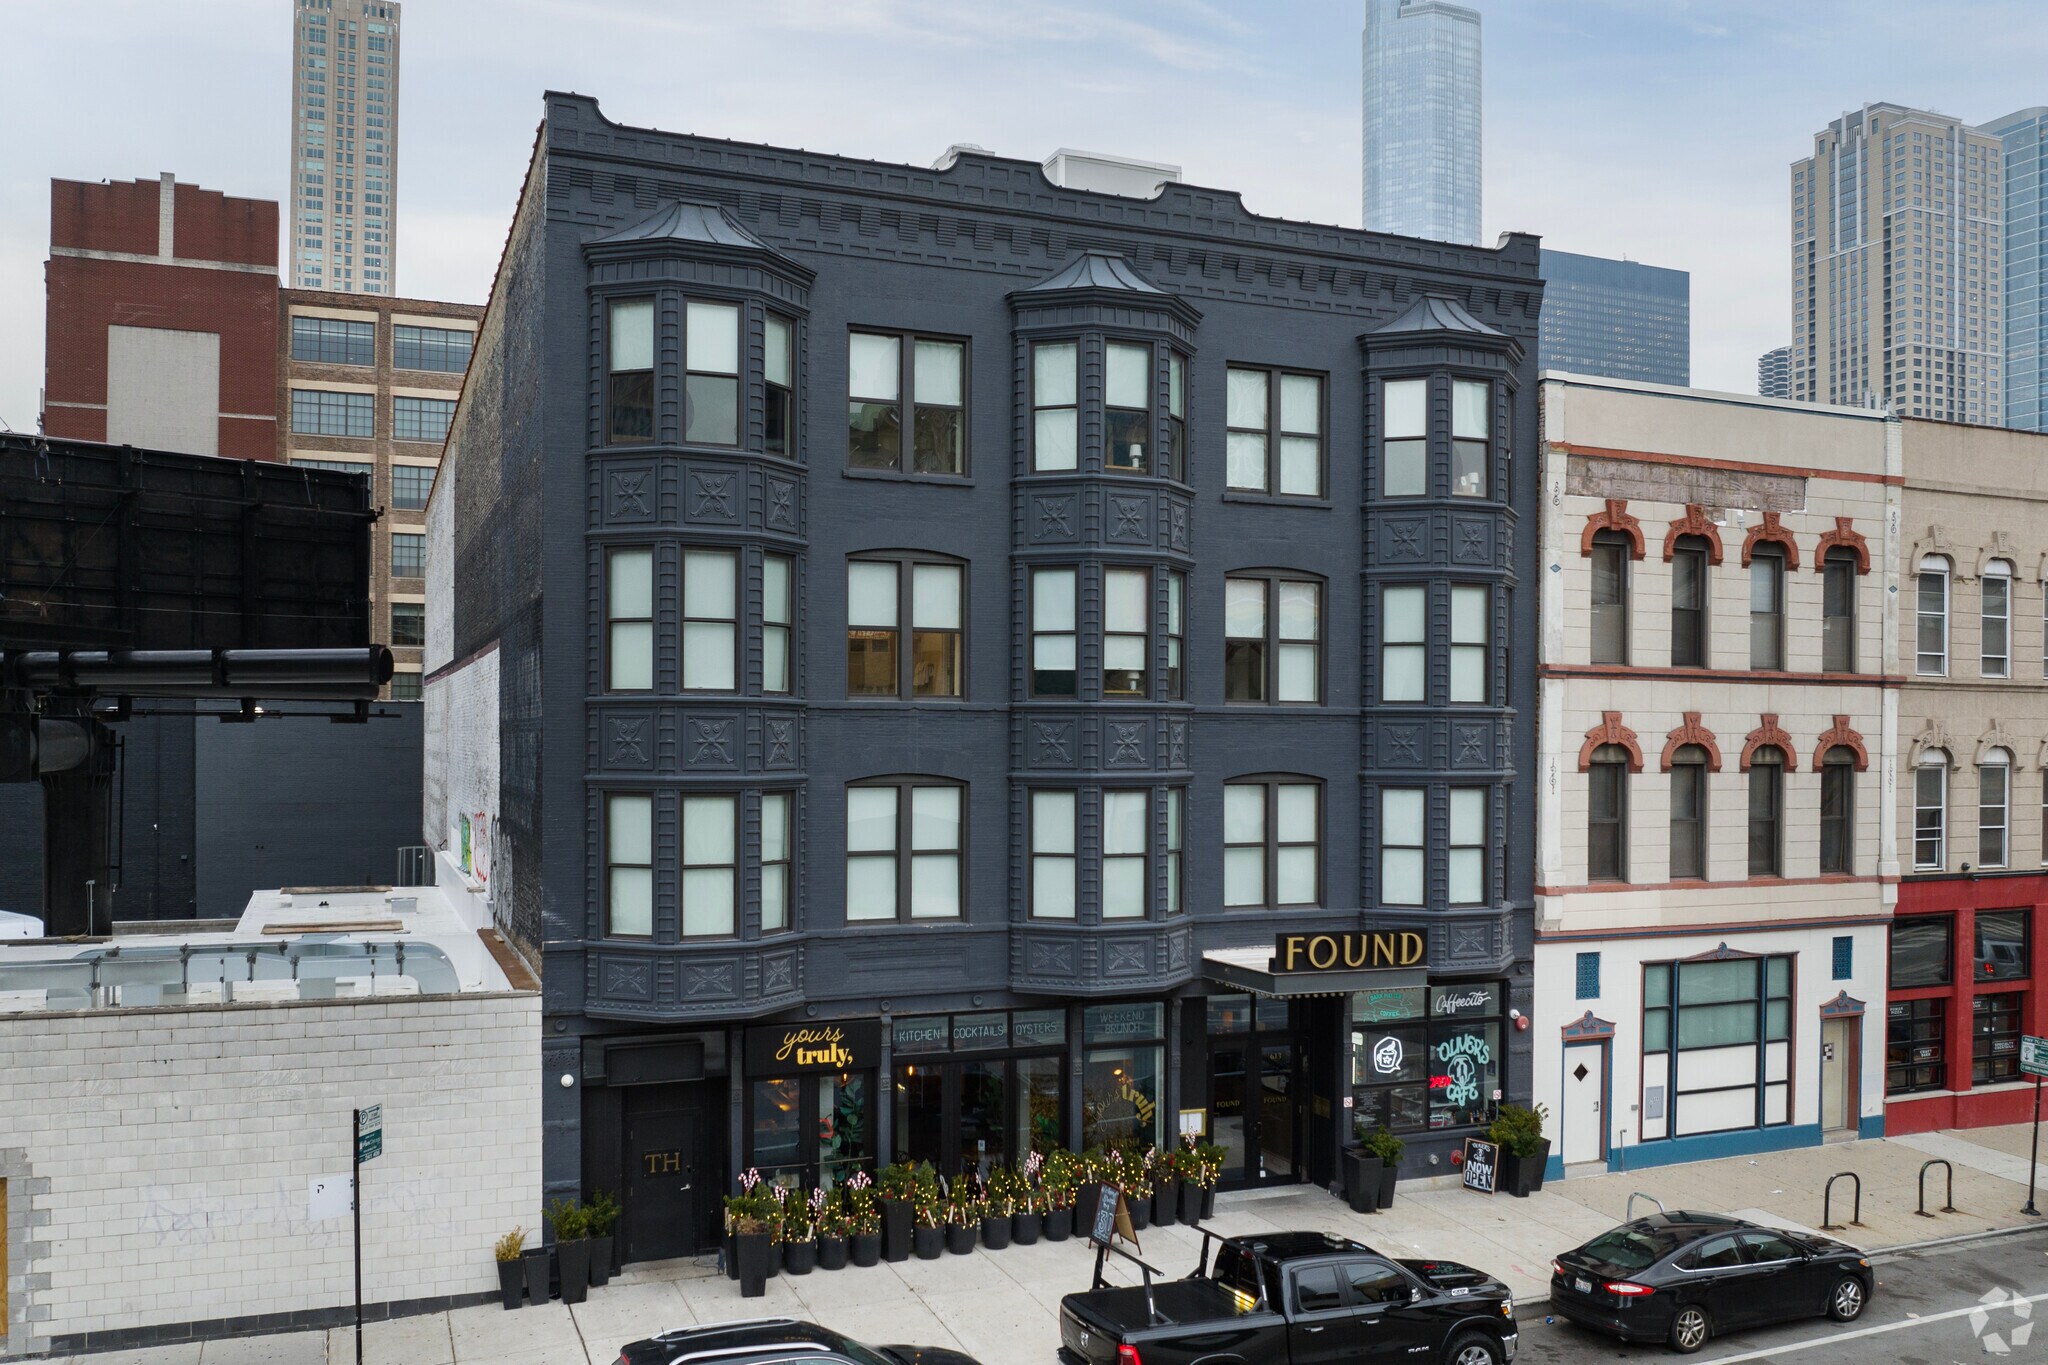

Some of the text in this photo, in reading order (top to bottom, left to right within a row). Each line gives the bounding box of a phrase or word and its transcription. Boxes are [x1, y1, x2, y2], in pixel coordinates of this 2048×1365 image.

[1286, 932, 1423, 971] FOUND
[1435, 990, 1492, 1014] Caffeecito
[1100, 1008, 1145, 1023] WEEKEND
[1379, 1010, 1401, 1018] COFFEE
[899, 1029, 941, 1042] KITCHEN
[953, 1025, 1004, 1039] COCKTAILS
[1015, 1021, 1057, 1036] OYSTERS
[1104, 1022, 1141, 1034] BRUNCH
[775, 1026, 845, 1061] yours
[1436, 1033, 1490, 1065] OLIVER'S
[796, 1043, 853, 1068] truly,
[1216, 1099, 1240, 1108] FOUND
[1263, 1096, 1287, 1104] FOUND
[644, 1152, 680, 1174] TH
[1467, 1160, 1493, 1175] NOW
[1464, 1169, 1493, 1190] OPEN
[1407, 1345, 1430, 1354] RAM
